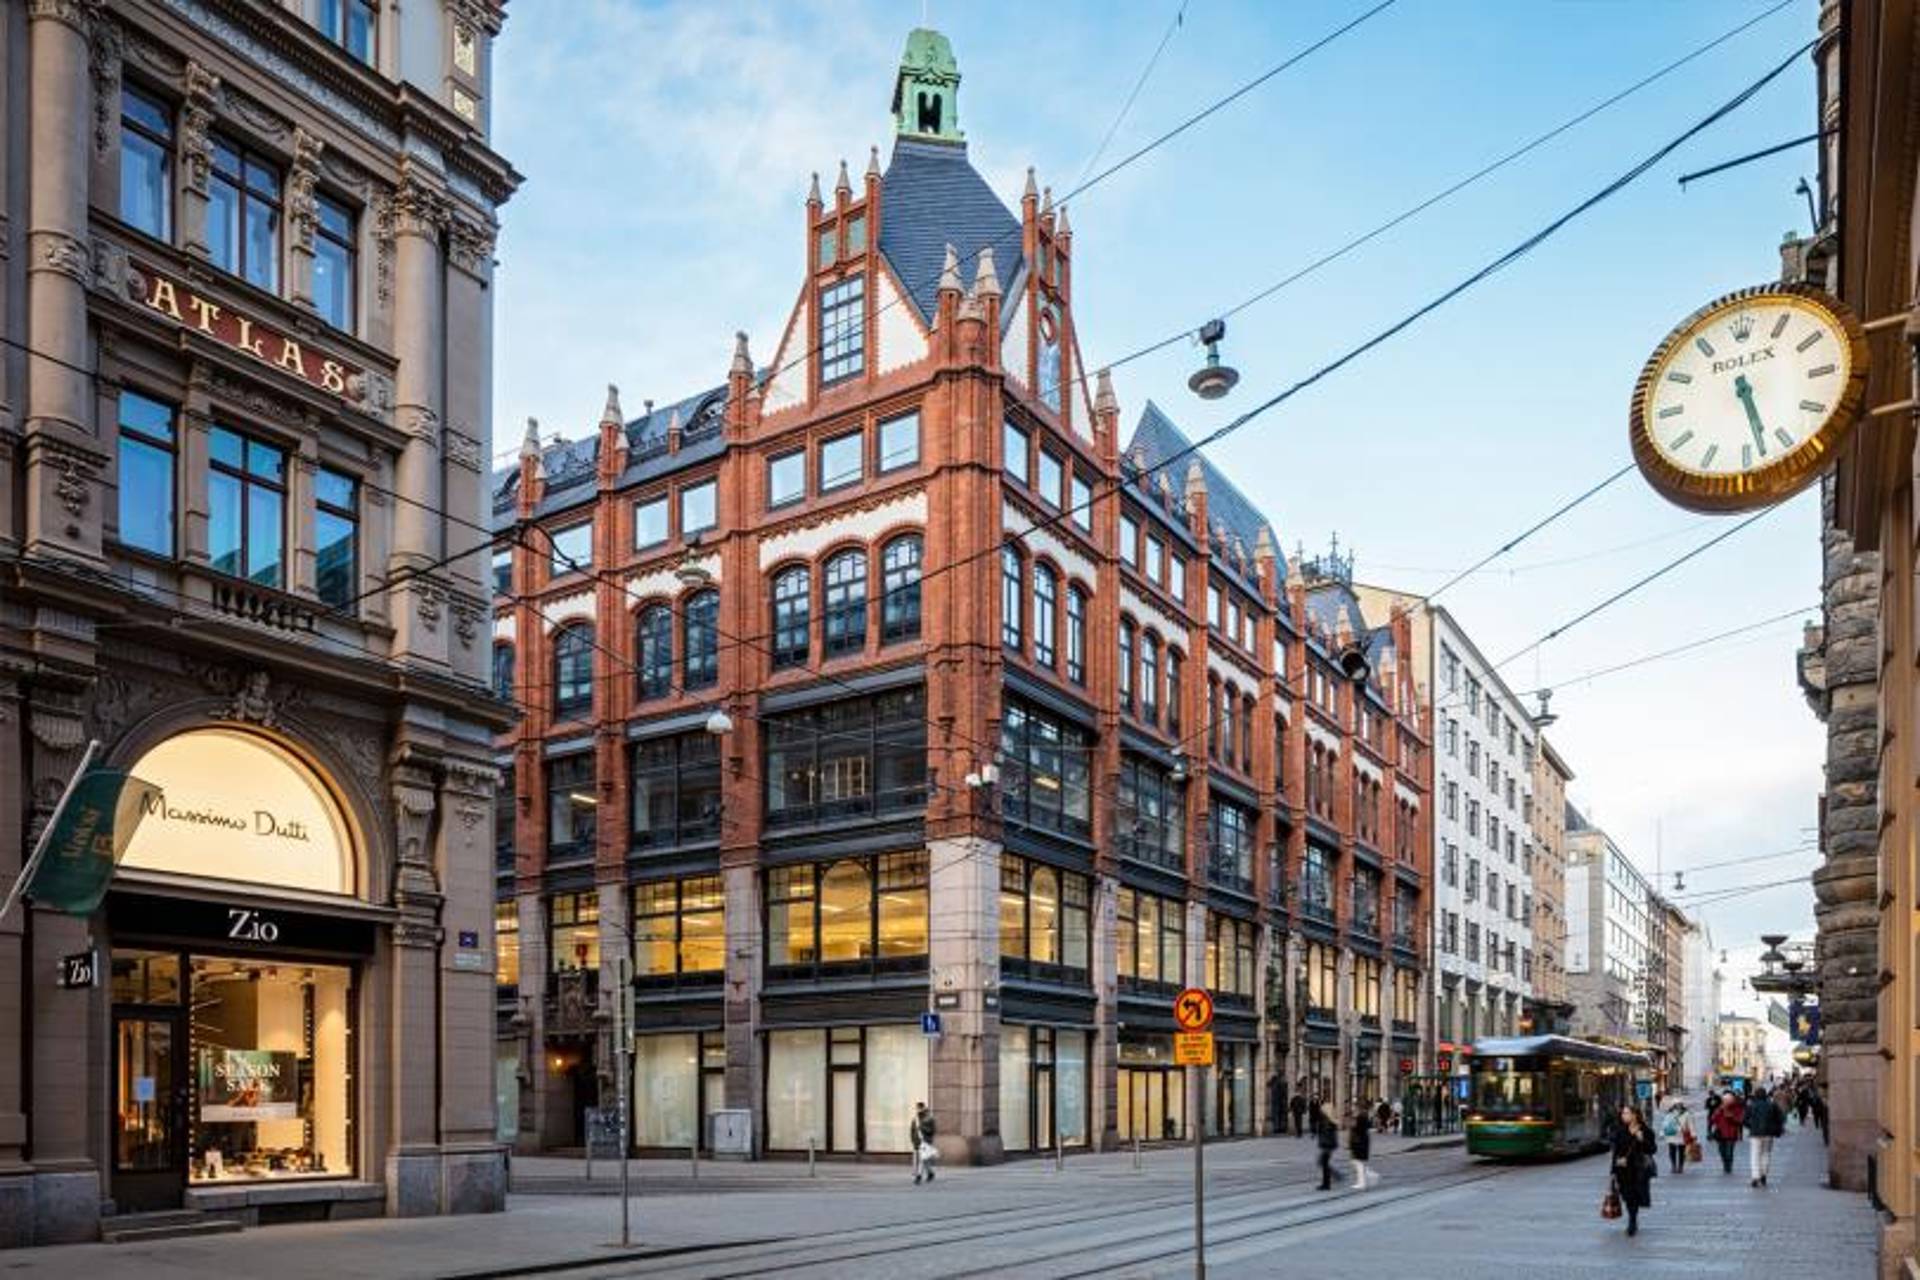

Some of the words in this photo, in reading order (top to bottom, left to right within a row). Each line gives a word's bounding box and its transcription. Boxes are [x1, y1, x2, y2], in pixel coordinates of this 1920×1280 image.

[146, 277, 345, 392] ATLAS
[1712, 344, 1777, 374] ROLEX
[138, 791, 246, 830] Massimo
[253, 810, 311, 842] Dutti
[228, 908, 279, 942] Zio
[69, 959, 92, 984] Zio
